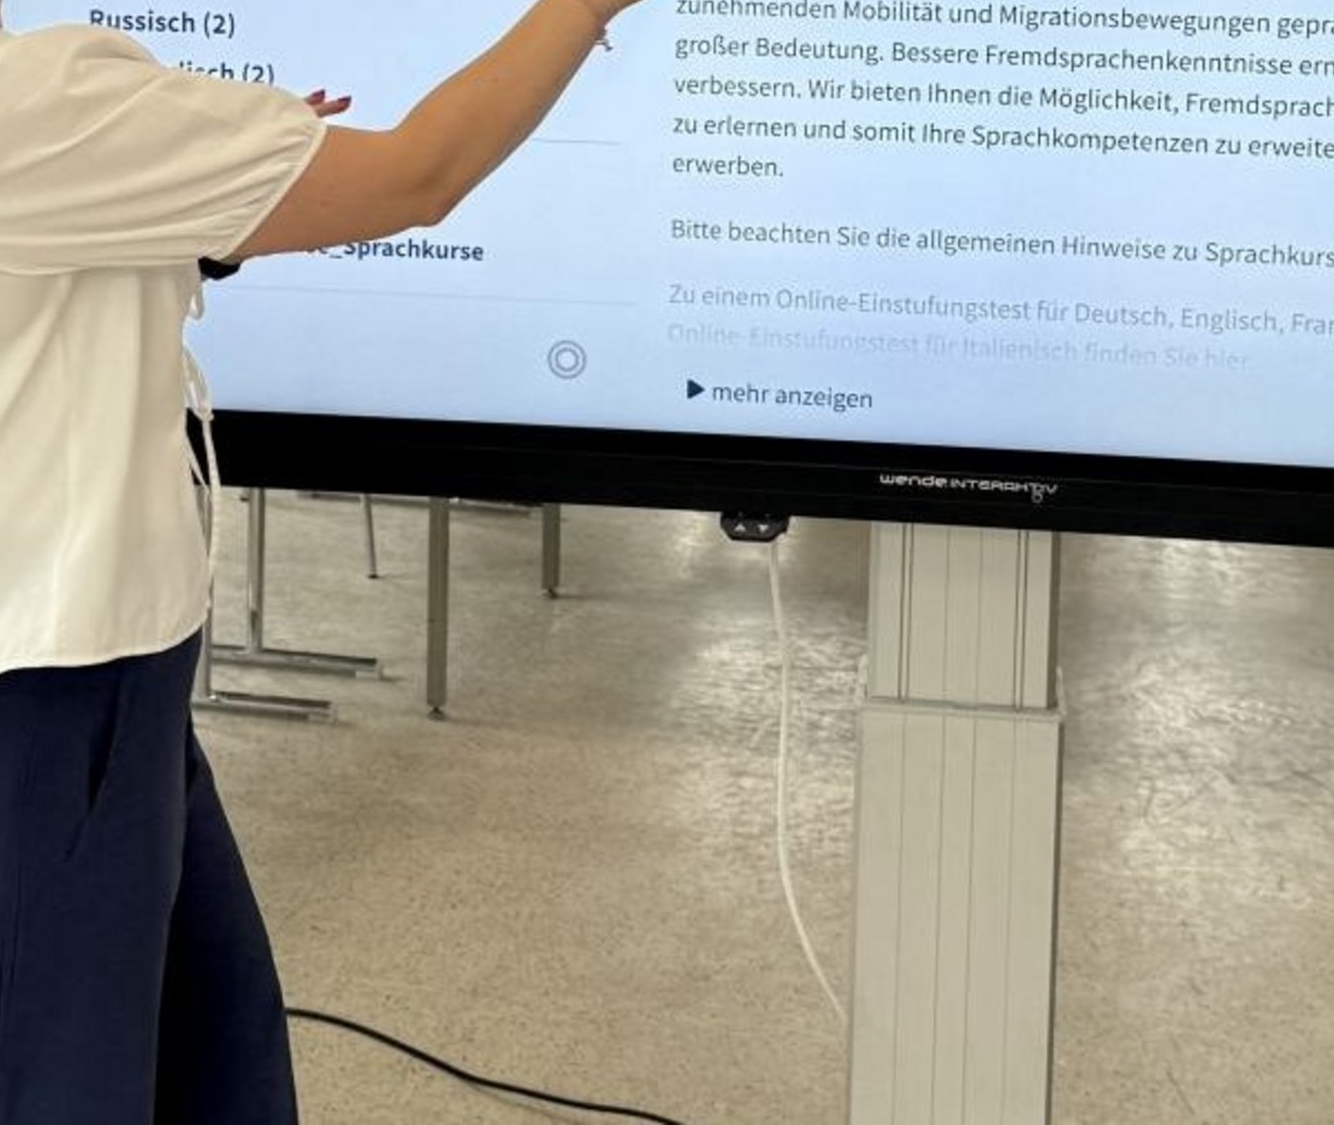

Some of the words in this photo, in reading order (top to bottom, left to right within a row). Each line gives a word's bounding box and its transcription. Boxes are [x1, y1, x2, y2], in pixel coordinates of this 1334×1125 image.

[203, 11, 236, 39] (2)
[843, 0, 943, 23] Mobilität
[948, 3, 993, 25] und
[999, 4, 1271, 39] Migrationsbewegungen
[674, 33, 750, 60] großer
[755, 36, 884, 67] Bedeutung.
[891, 41, 980, 65] Bessere
[985, 44, 1293, 76] Fremdsprachenkenntnisse
[674, 74, 802, 99] verbessern.
[807, 79, 846, 99] Wir
[850, 79, 922, 103] bieten
[927, 82, 992, 105] Ihnen
[997, 85, 1034, 107] die
[1039, 87, 1180, 115] Möglichkeit,
[672, 117, 698, 135] zu
[703, 115, 798, 138] erlernen
[803, 119, 847, 140] und
[852, 121, 916, 144] somit
[922, 122, 966, 145] Ihre
[972, 124, 1209, 155] Sprachkompetenzen
[1214, 138, 1242, 156] zu
[672, 155, 784, 177] erwerben.
[671, 218, 722, 241] Bitte
[728, 220, 831, 245] beachten
[837, 225, 871, 247] Sie
[876, 226, 911, 249] die
[915, 229, 1056, 257] allgemeinen
[1061, 235, 1167, 260] Hinweise
[1172, 244, 1199, 262] zu
[668, 283, 696, 305] Zu
[701, 289, 771, 307] einem
[775, 288, 1031, 324] Online-Einstufungstest
[1036, 299, 1070, 322] für
[1074, 302, 1175, 330] Deutsch,
[1180, 307, 1285, 336] Englisch,
[711, 383, 770, 403] mehr
[774, 387, 873, 413] anzeigen
